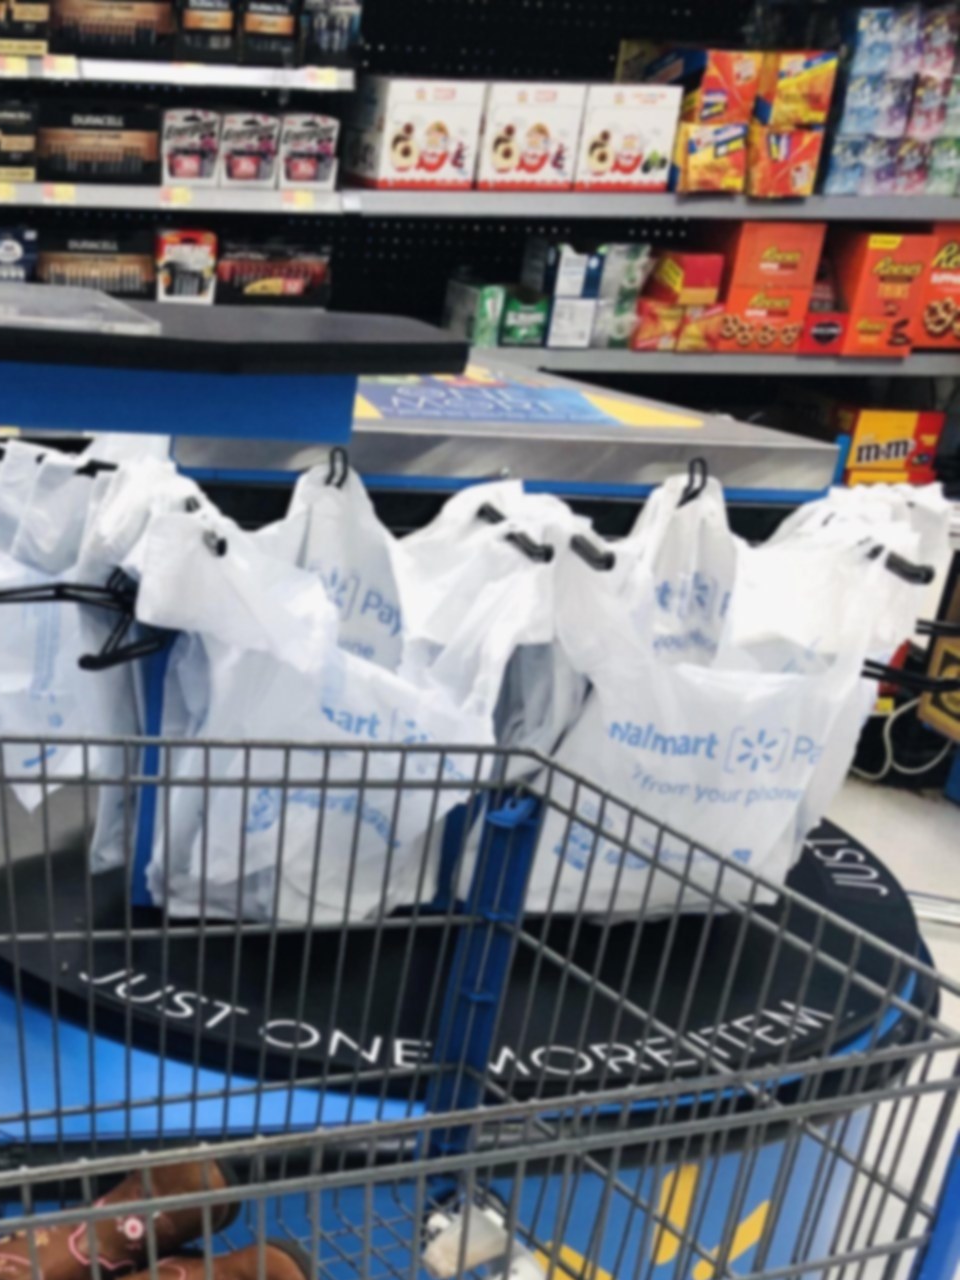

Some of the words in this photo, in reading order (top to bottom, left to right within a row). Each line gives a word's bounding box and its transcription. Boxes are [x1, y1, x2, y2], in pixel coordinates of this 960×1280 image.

[70, 114, 124, 127] DURACELL
[695, 783, 743, 805] your
[79, 969, 249, 1029] JUST
[258, 1019, 433, 1069] ONE
